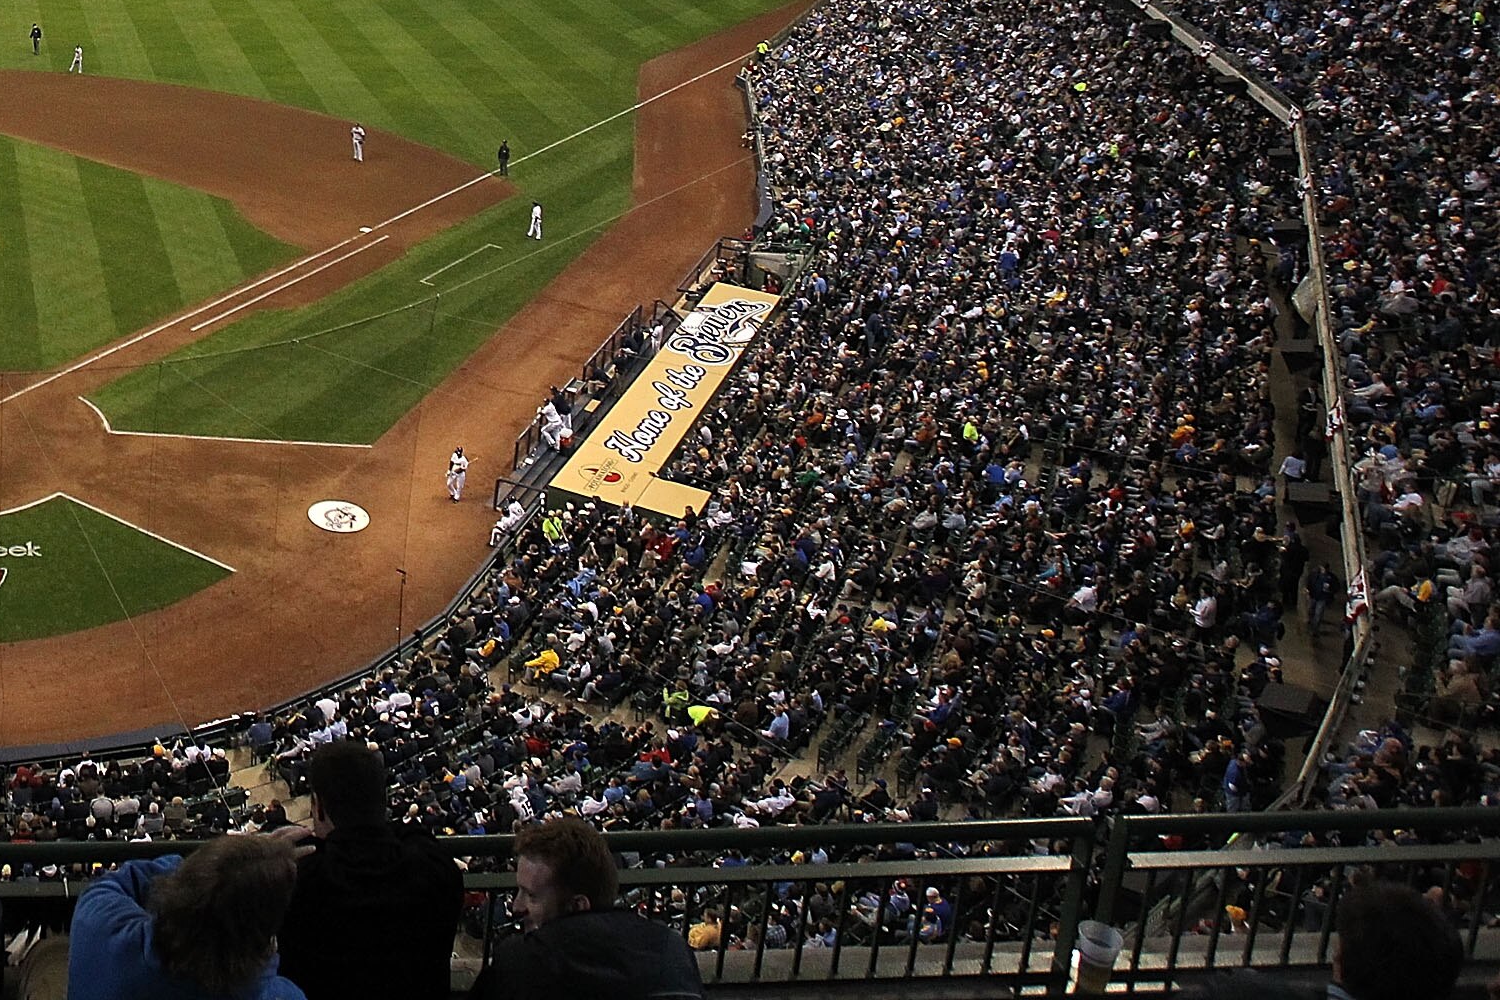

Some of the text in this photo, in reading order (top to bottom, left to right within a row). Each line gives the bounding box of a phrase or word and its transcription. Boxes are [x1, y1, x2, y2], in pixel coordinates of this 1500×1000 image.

[604, 300, 773, 463] Home of the Brewers
